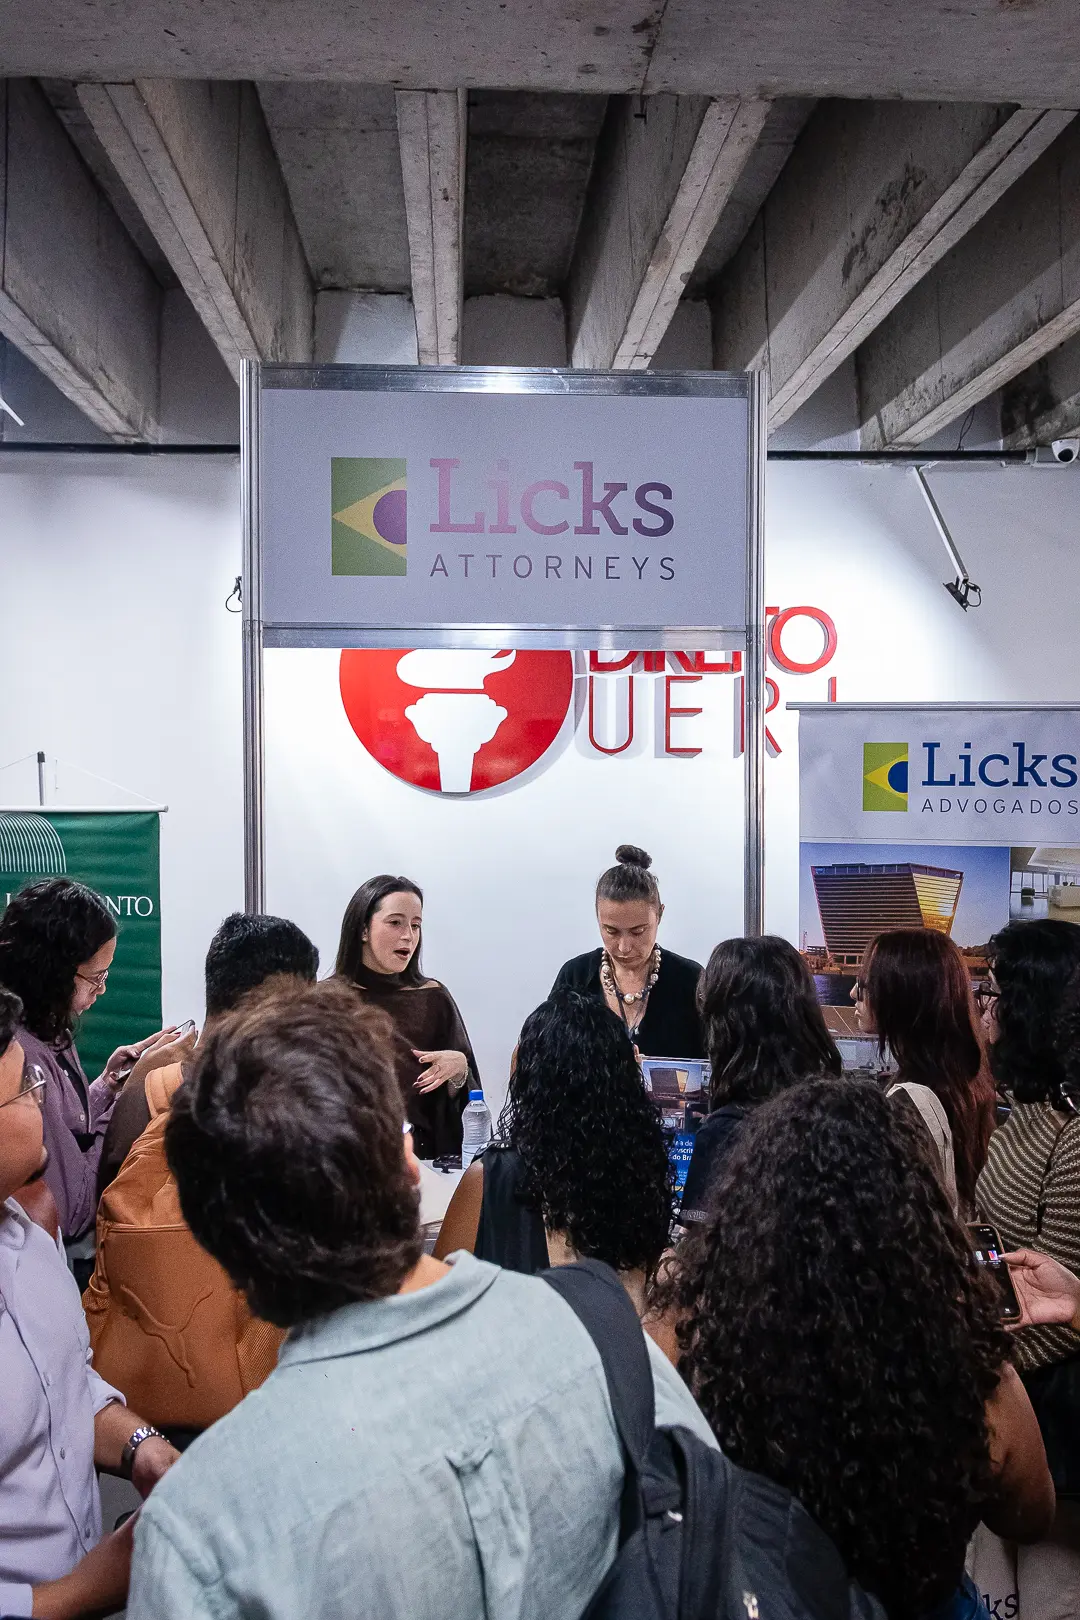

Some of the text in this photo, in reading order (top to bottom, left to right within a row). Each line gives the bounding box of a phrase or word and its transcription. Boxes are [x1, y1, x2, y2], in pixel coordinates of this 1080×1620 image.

[429, 457, 675, 538] Licks
[429, 553, 676, 581] ATTORNEYS
[921, 741, 1079, 788] Licks
[921, 798, 1080, 815] ADVOGADOS
